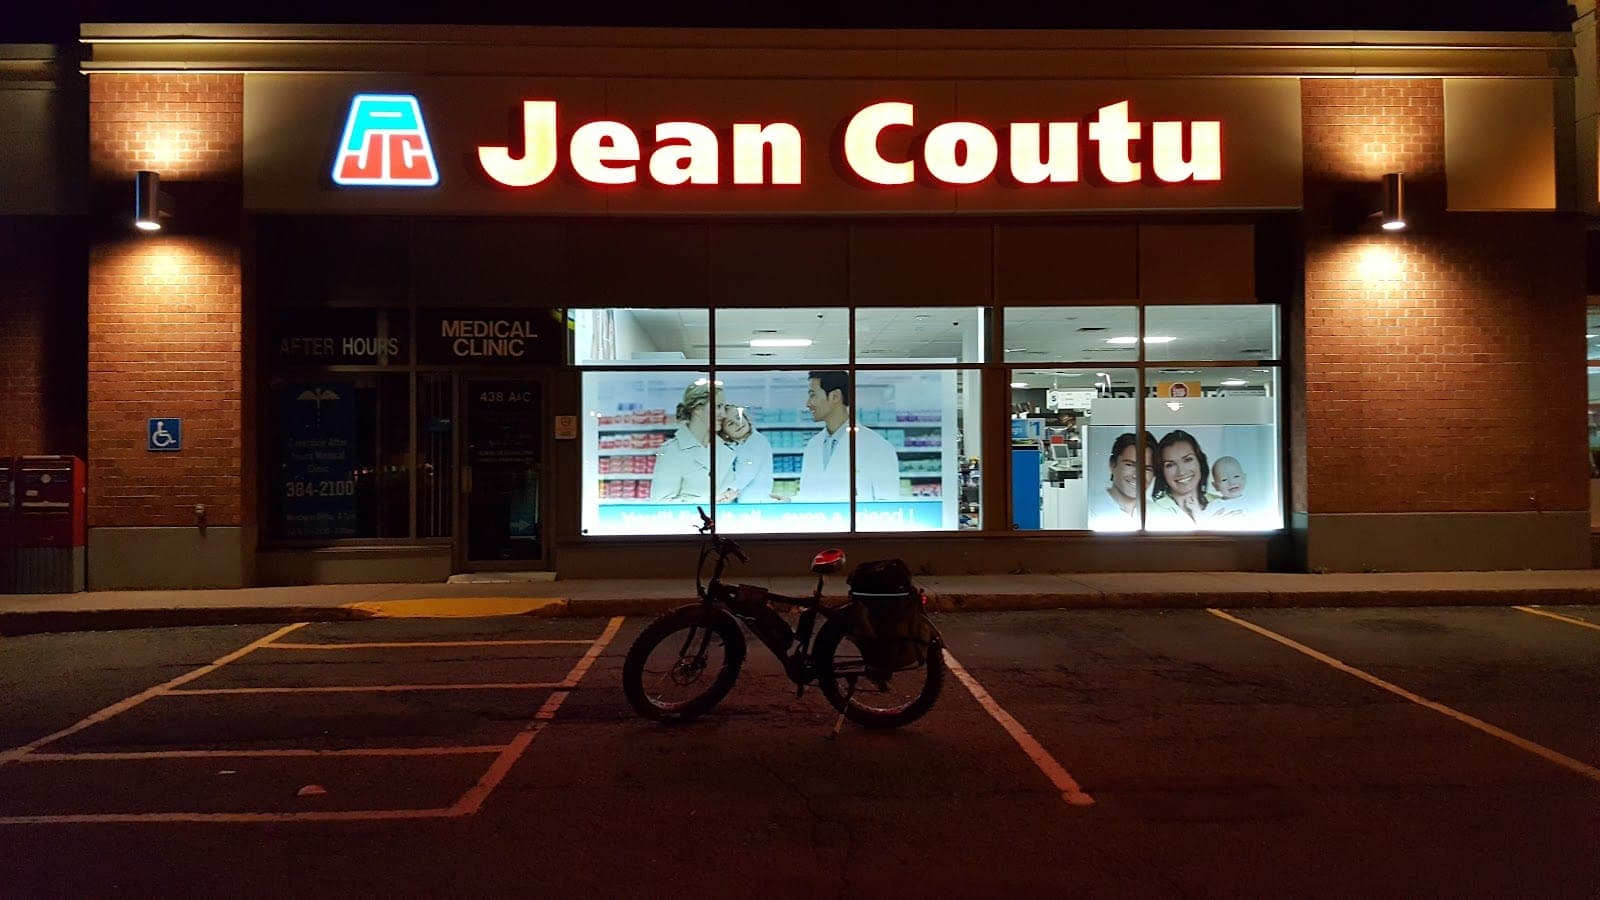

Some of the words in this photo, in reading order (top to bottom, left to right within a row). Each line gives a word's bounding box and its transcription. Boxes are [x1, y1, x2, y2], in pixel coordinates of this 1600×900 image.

[478, 100, 802, 187] Jean
[843, 100, 1222, 185] Coutu
[441, 320, 538, 339] MEDICAL
[279, 337, 335, 356] AFTER
[342, 337, 400, 356] HOURS
[453, 338, 525, 357] CLINIC
[480, 391, 504, 402] 438
